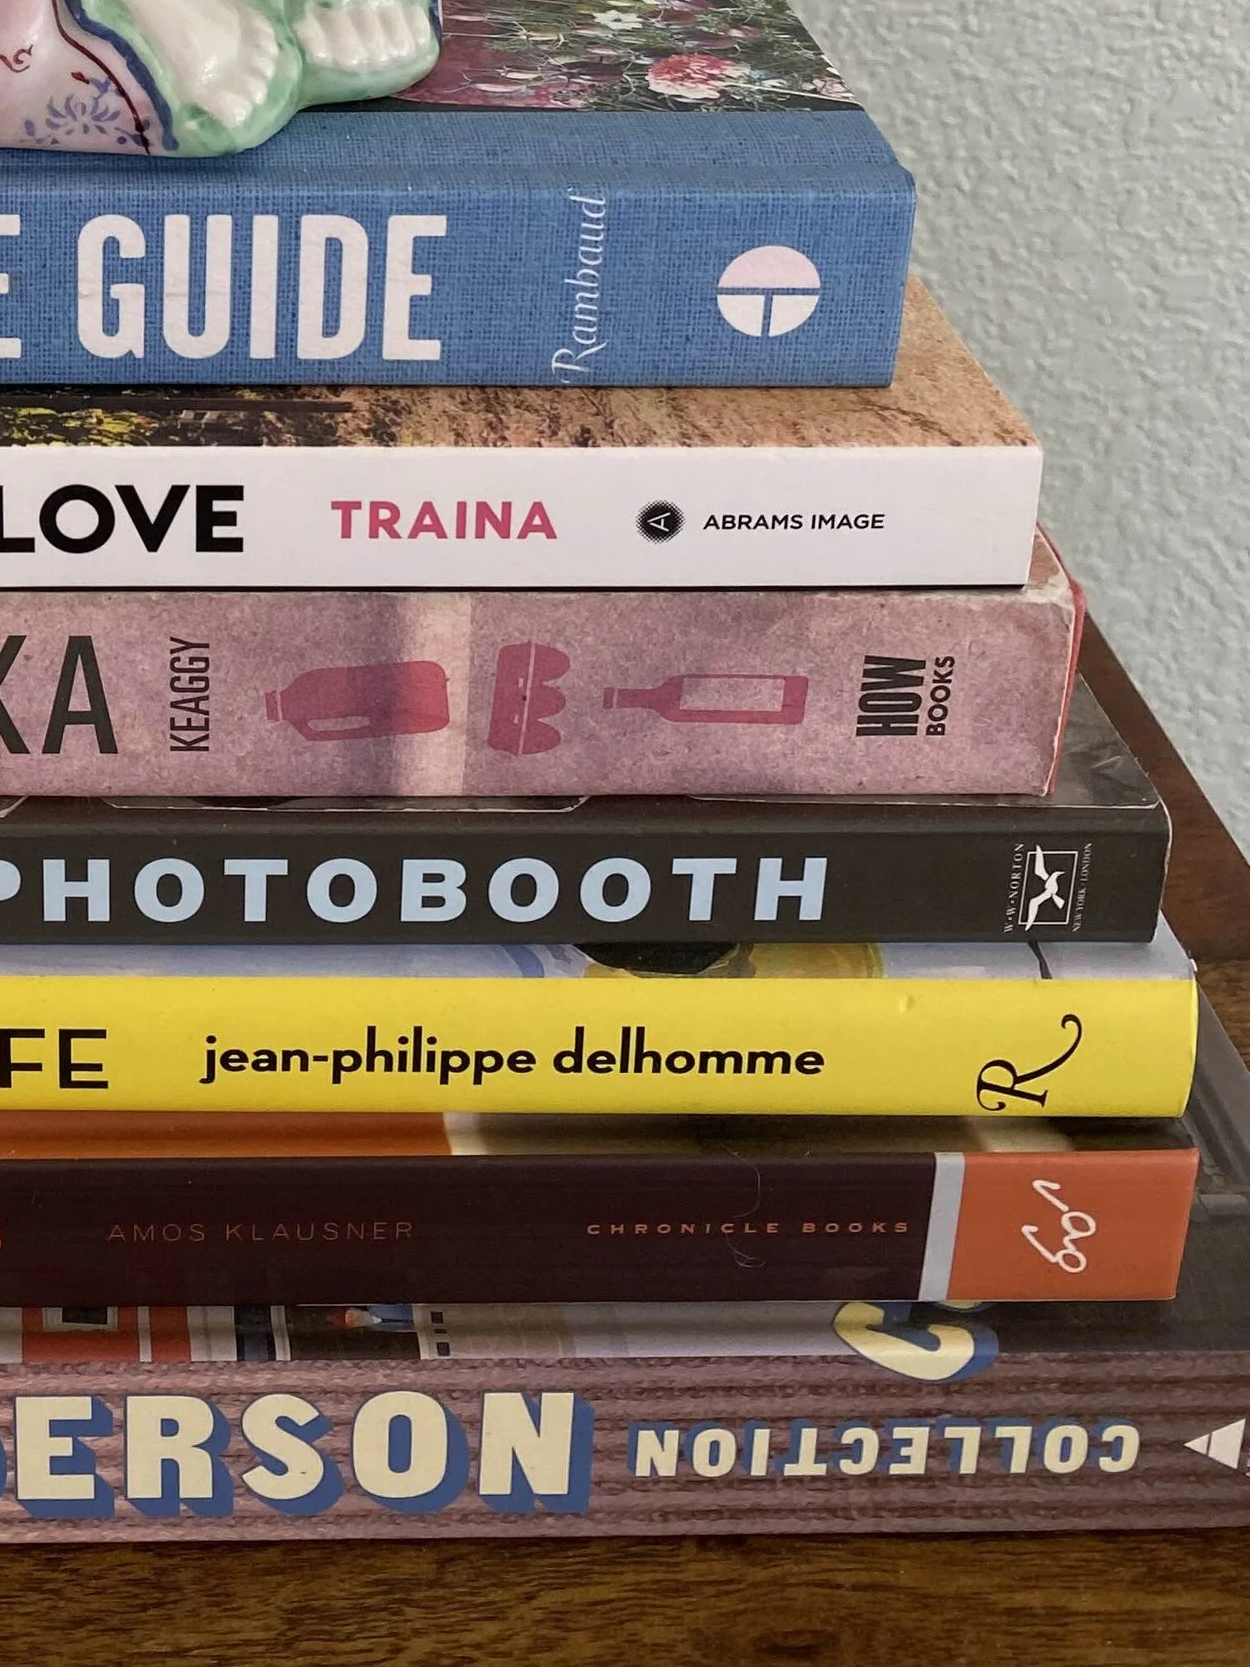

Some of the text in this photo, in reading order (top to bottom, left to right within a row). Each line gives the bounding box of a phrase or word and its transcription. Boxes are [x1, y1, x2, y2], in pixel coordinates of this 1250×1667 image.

[77, 213, 447, 361] GUIDE
[551, 187, 608, 384] Rambaud
[330, 499, 559, 540] TRAINA
[702, 513, 886, 531] ABRAMS IMAGE
[169, 636, 211, 752] KEAGGY
[855, 654, 927, 736] HOW
[925, 655, 956, 736] BOOKS
[1079, 842, 1093, 882] LONDON
[1075, 887, 1087, 911] YORK
[198, 1024, 826, 1086] jean-philippe delhomme
[106, 1221, 414, 1243] AMOS KLAUSNER
[586, 1221, 908, 1235] CHRONICLE BOOKS
[627, 1419, 1142, 1478] COLLECTION
